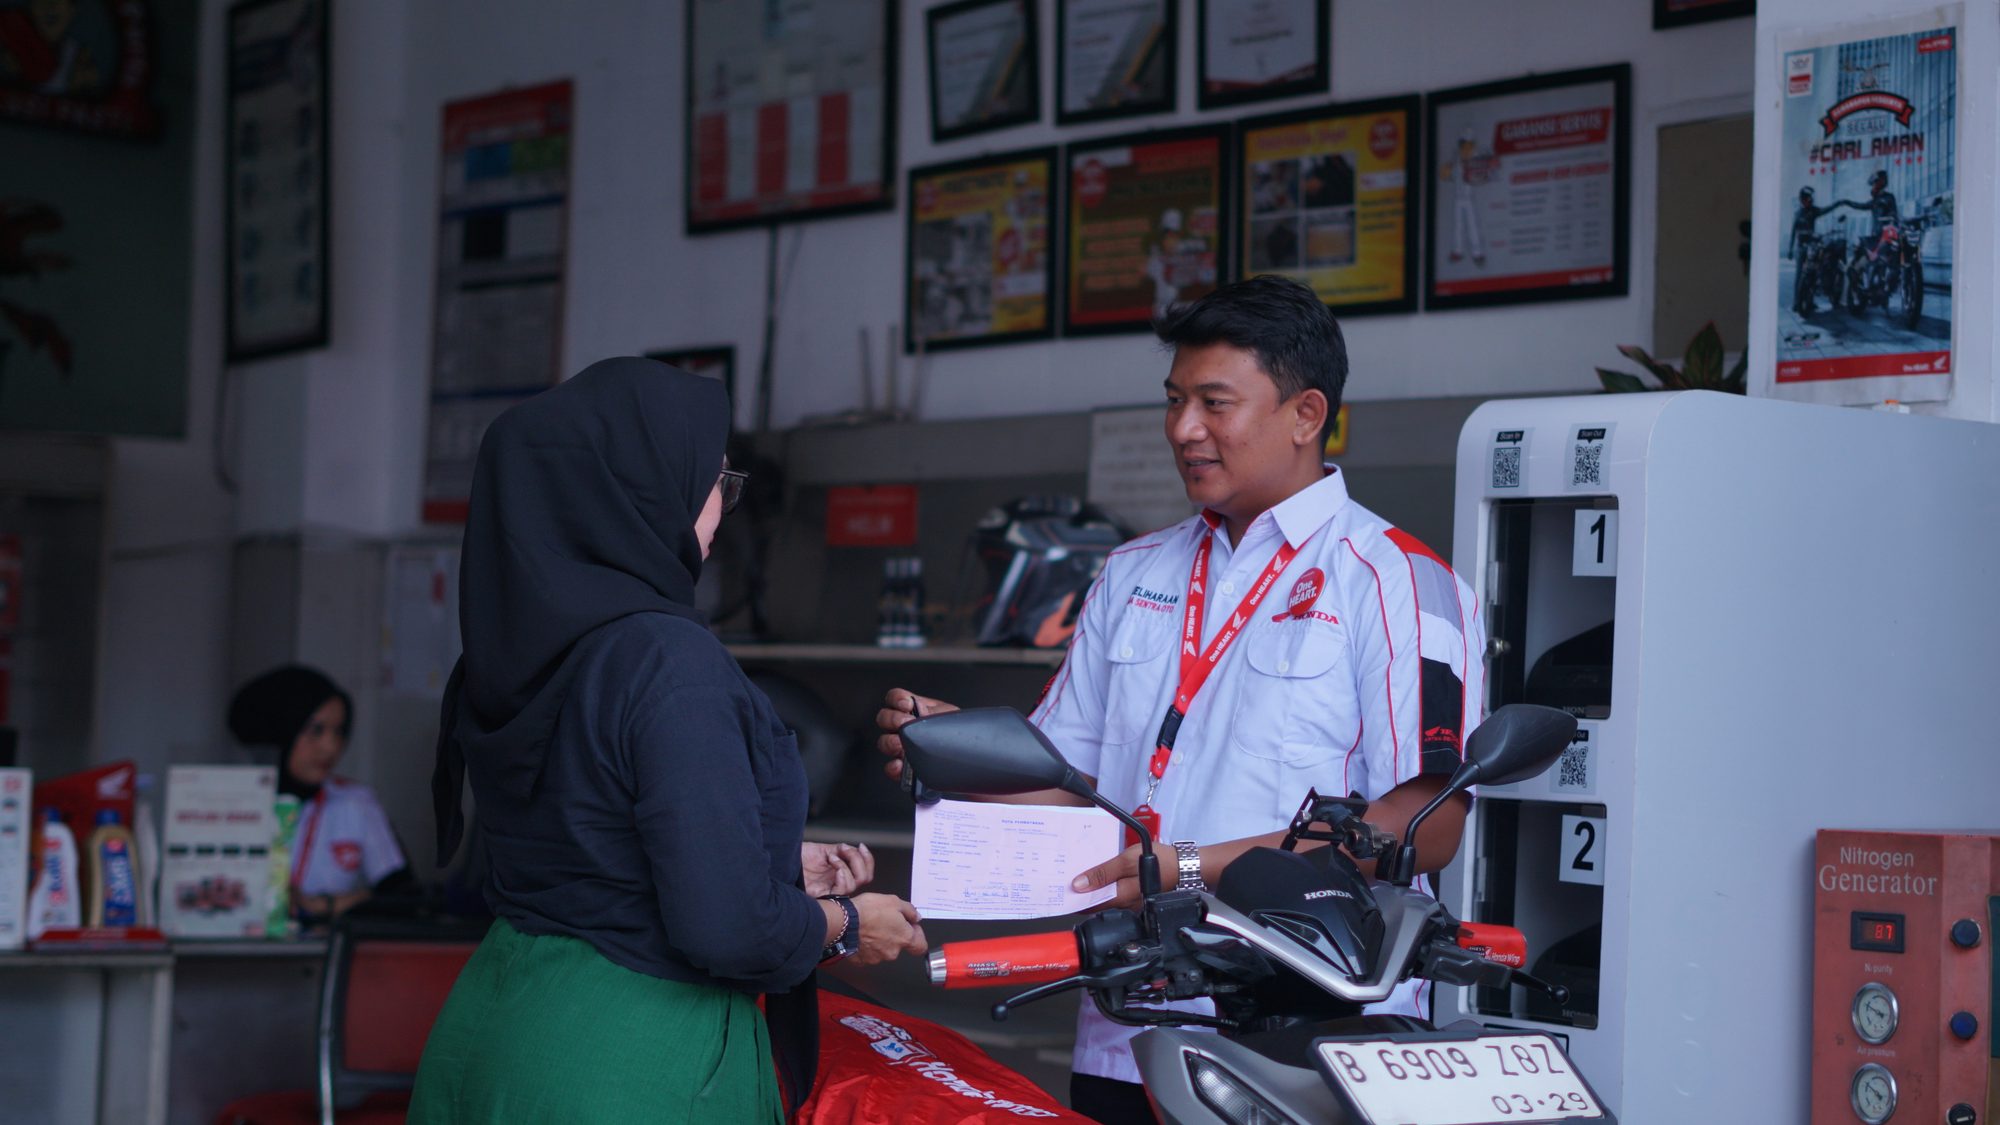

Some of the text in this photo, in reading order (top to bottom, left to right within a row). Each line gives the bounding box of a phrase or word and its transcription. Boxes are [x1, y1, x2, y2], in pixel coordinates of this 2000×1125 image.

[1848, 120, 1886, 132] SELALU
[1590, 514, 1606, 563] 1
[1131, 586, 1179, 604] ELIHARAAN
[1250, 574, 1275, 605] One HEART.
[1289, 586, 1317, 607] HEART.
[1297, 580, 1313, 594] One
[1209, 631, 1234, 662] One HEART.
[1572, 821, 1595, 870] 2
[1840, 847, 1914, 870] Nitrogen
[1818, 864, 1937, 896] Generator
[1304, 890, 1353, 900] HONDA
[1334, 1050, 1367, 1083] B
[1377, 1047, 1478, 1080] 6909
